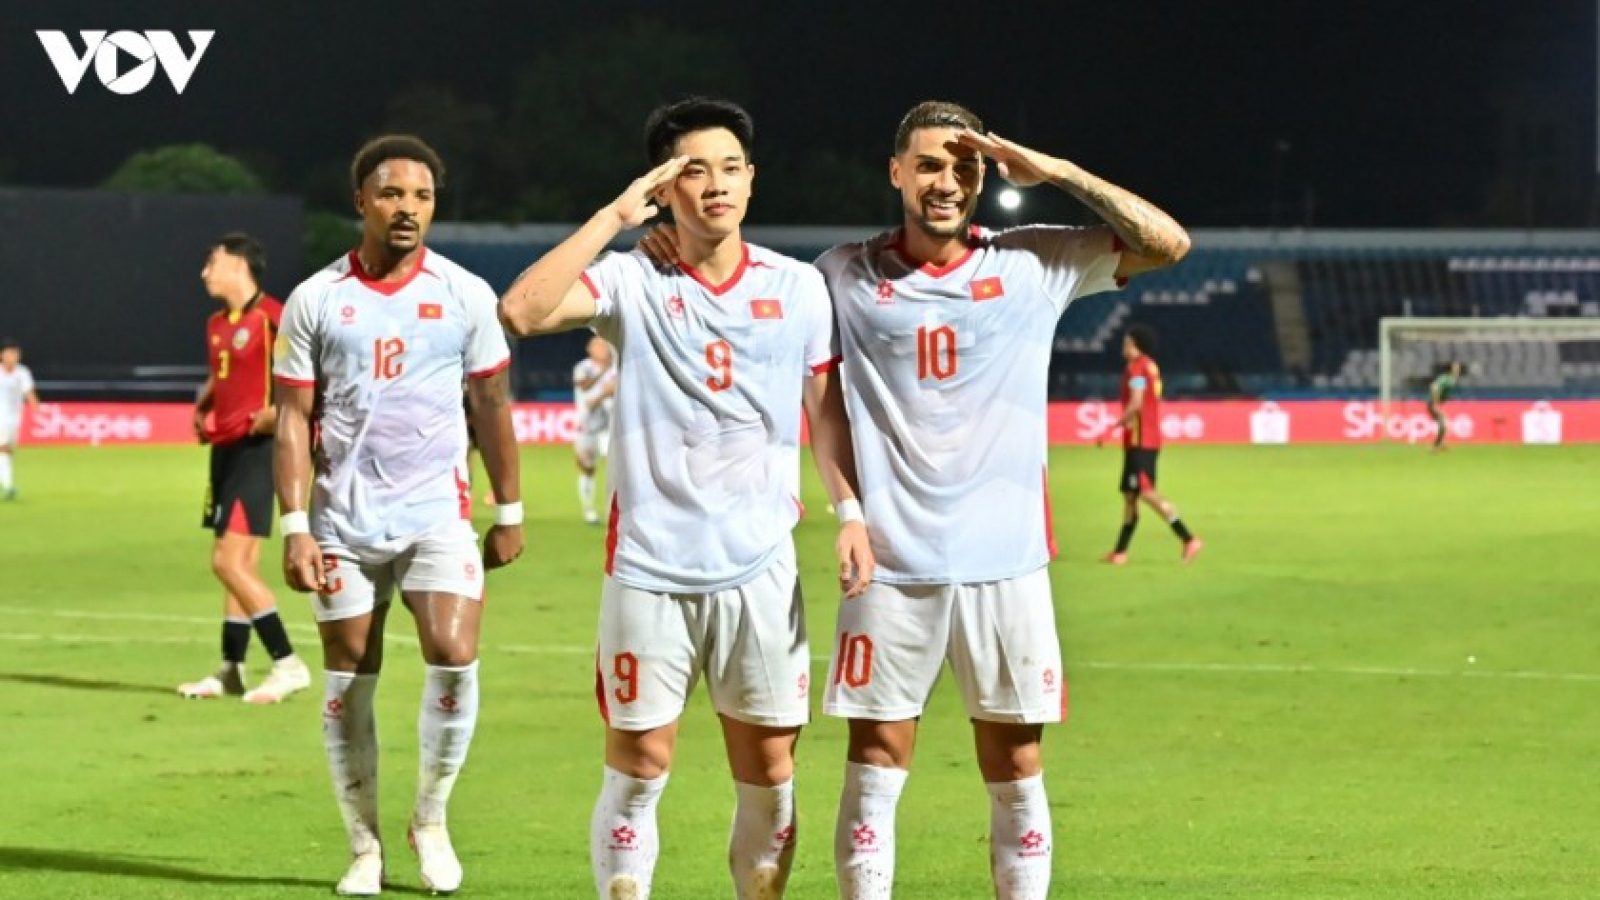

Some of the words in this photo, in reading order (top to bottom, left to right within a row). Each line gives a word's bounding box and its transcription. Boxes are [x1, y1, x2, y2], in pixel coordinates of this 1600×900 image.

[373, 337, 406, 380] 12
[705, 339, 733, 392] 9
[916, 325, 957, 381] 10
[32, 402, 152, 446] Shopee
[1076, 400, 1204, 440] Shee
[1343, 401, 1474, 444] Shope
[614, 651, 639, 705] 9
[834, 632, 873, 688] 10
